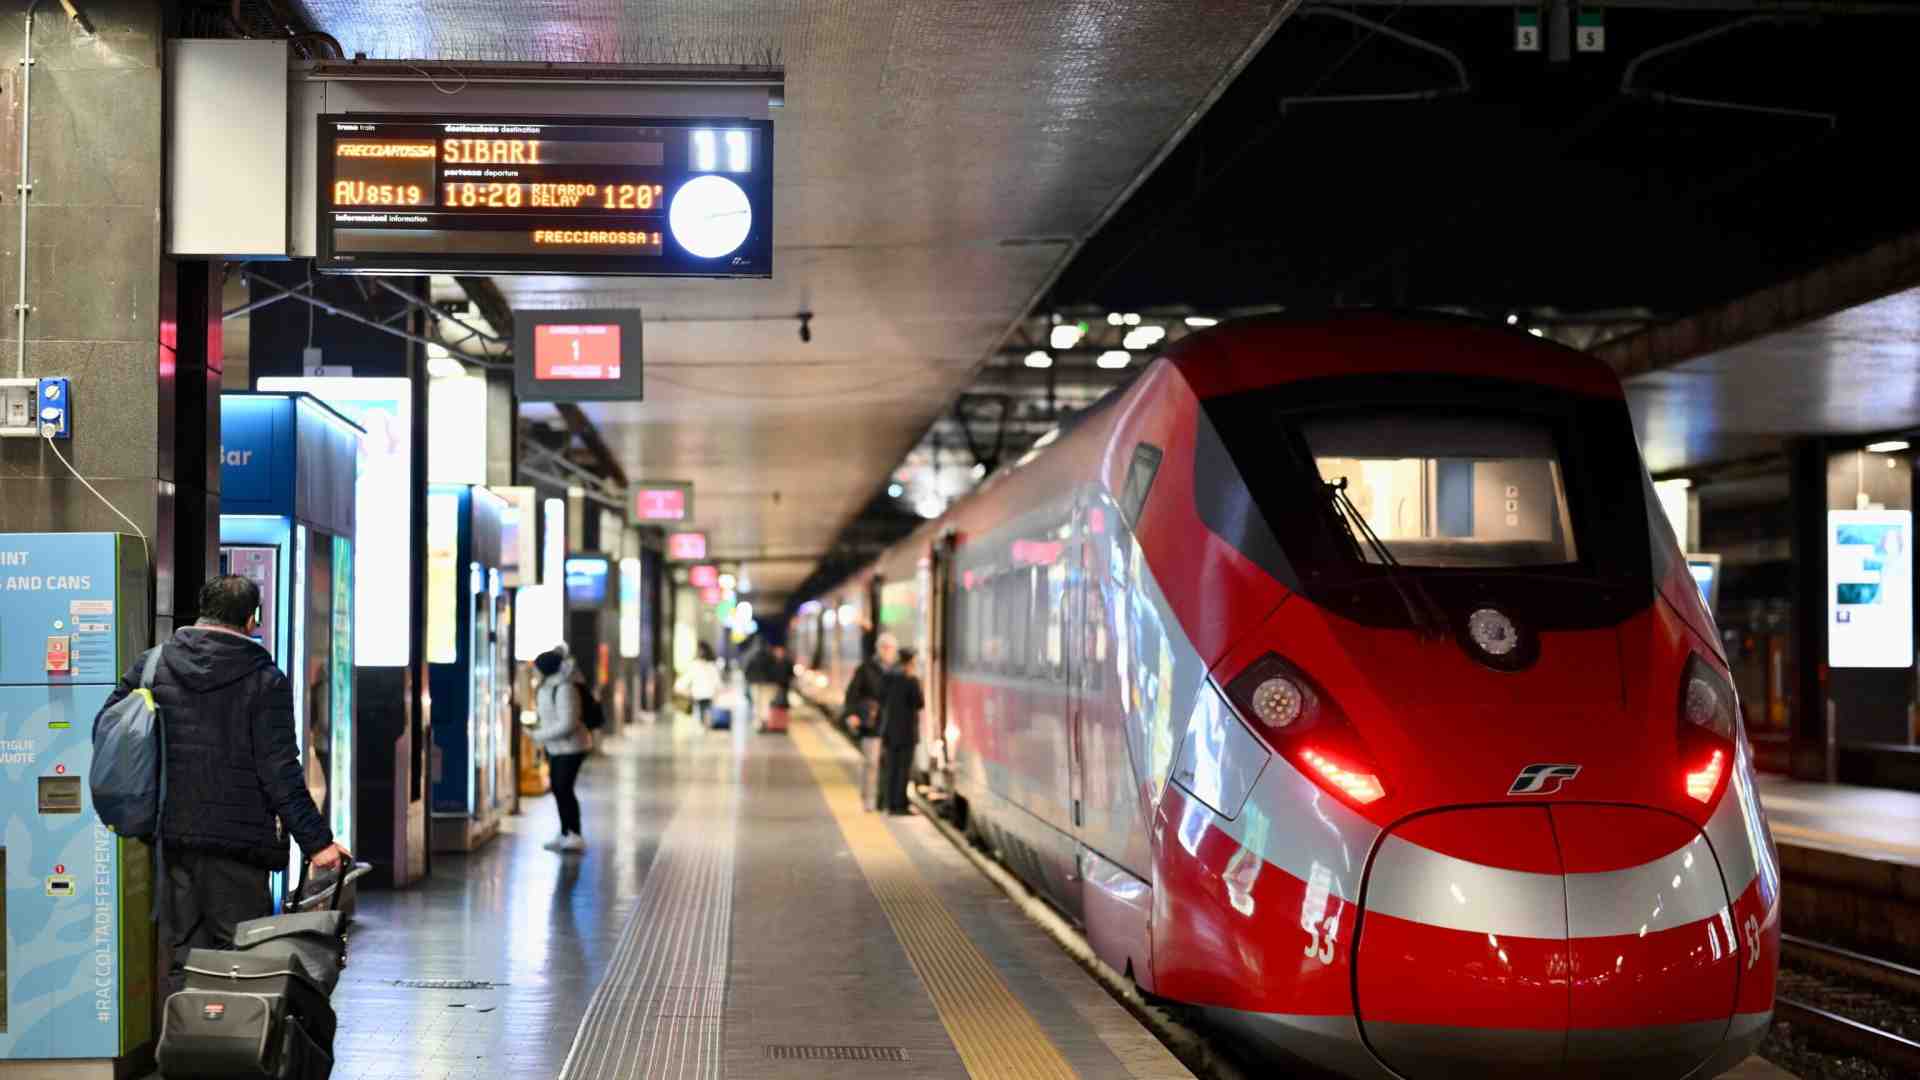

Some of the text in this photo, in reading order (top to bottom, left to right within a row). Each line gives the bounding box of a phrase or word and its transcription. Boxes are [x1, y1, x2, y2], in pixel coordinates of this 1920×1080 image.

[500, 124, 541, 133] destination
[444, 139, 540, 163] SIBARI
[694, 130, 746, 172] 11
[484, 168, 519, 178] departure
[445, 183, 522, 207] 18:20
[531, 184, 596, 196] RITARDO
[531, 194, 580, 207] DELAY
[389, 214, 428, 222] information
[534, 231, 660, 244] FRECCIAROSSA 1
[571, 339, 580, 360] 1
[6, 576, 91, 590] AND CANS
[1744, 914, 1760, 970] 53
